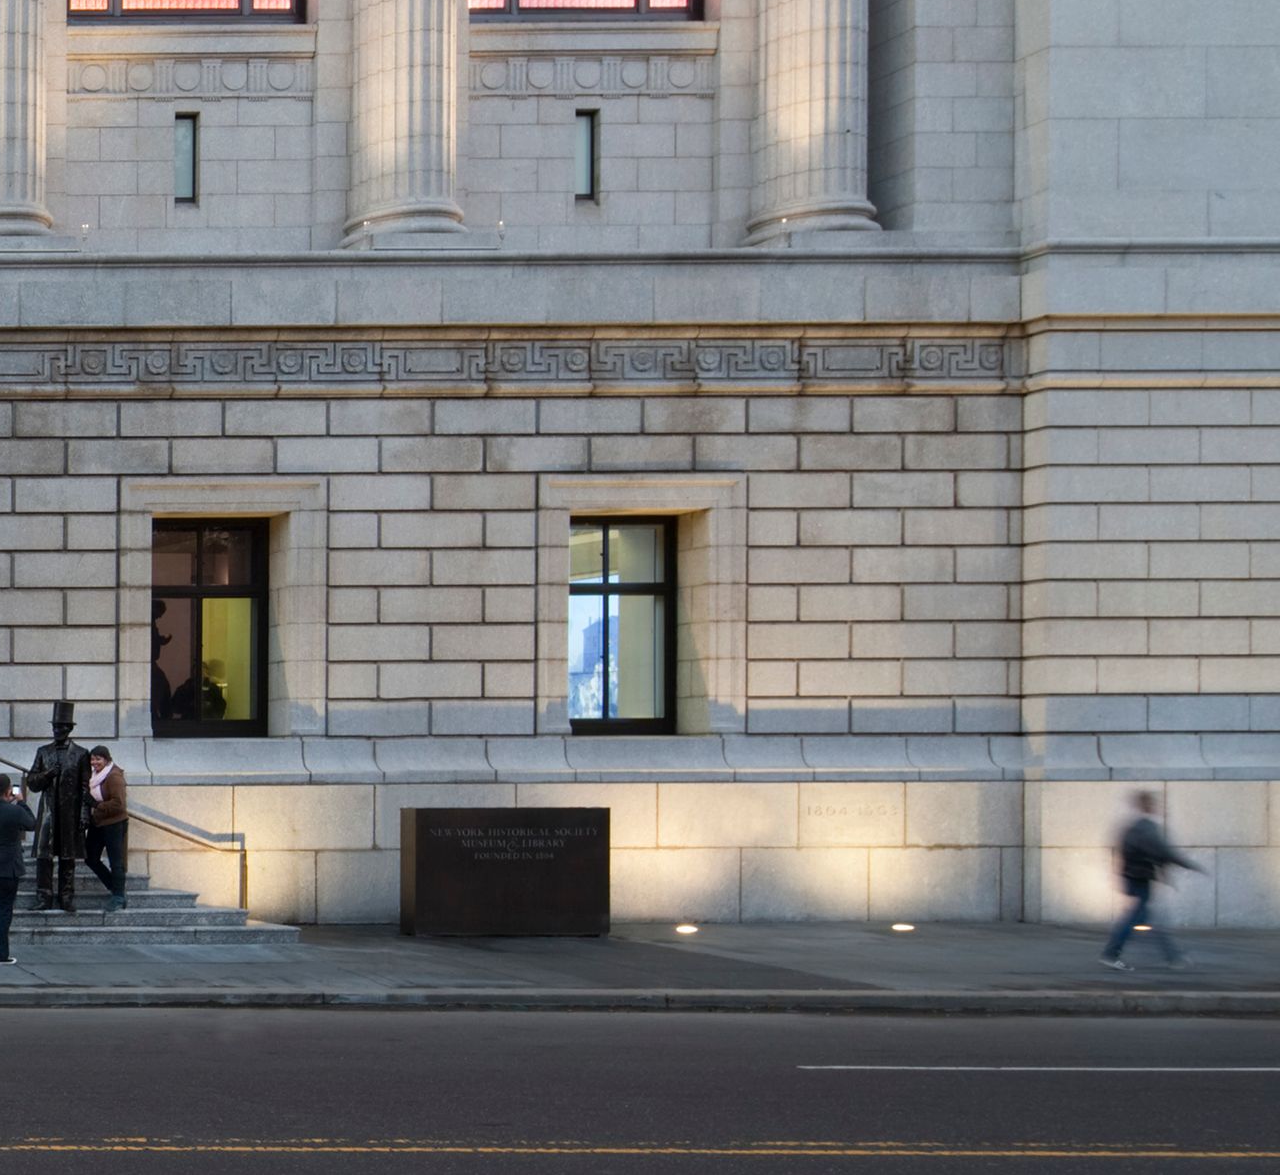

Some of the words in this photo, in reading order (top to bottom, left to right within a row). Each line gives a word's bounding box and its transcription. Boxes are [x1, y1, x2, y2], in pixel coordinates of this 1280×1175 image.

[488, 827, 550, 837] HISTORICAL
[554, 827, 598, 837] SOCIETY
[461, 839, 506, 848] MUSEUM
[522, 839, 566, 848] LIBRARY
[473, 851, 520, 860] FOUNDED
[521, 851, 533, 860] IN
